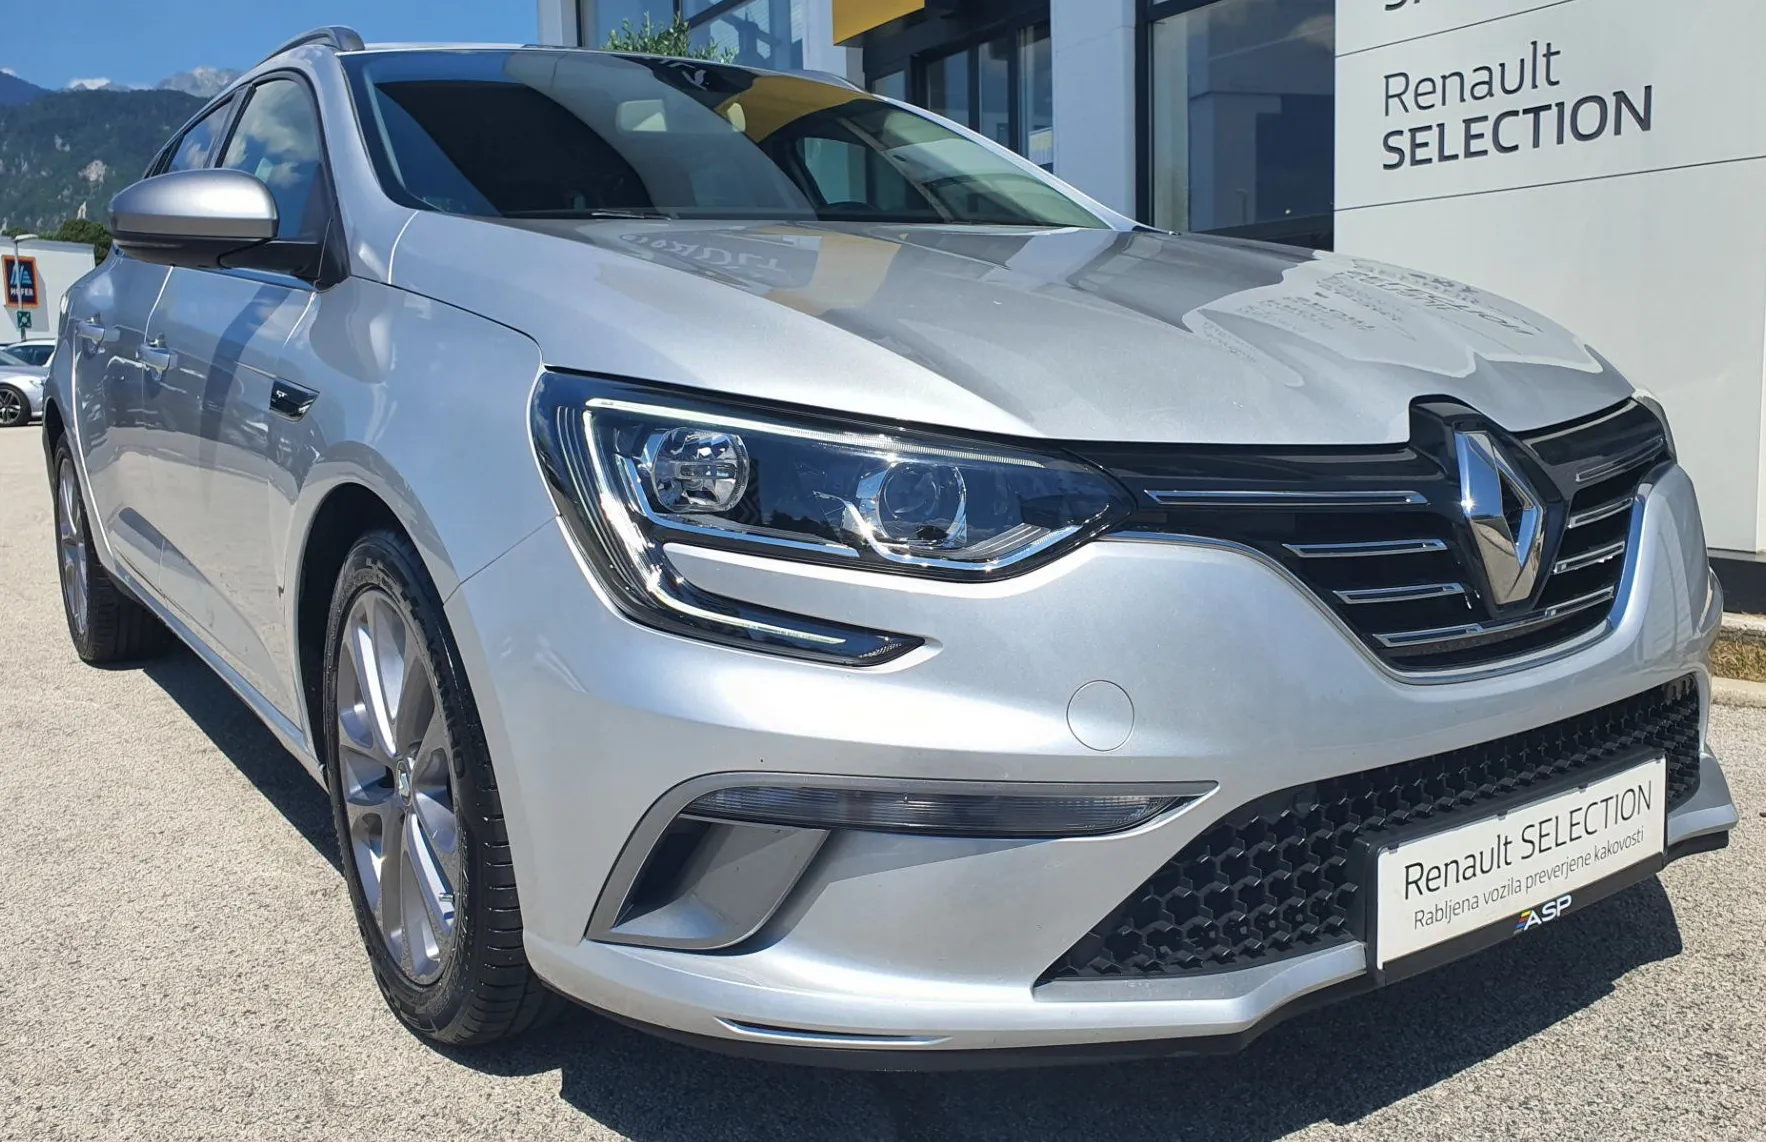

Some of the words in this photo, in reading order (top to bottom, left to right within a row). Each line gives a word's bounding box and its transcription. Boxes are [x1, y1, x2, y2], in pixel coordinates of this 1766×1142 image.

[1384, 41, 1561, 117] Renault
[1383, 85, 1653, 171] SELECTION
[1405, 834, 1513, 900] Renault
[1521, 780, 1652, 860] SELECTION
[1414, 895, 1479, 930] Rabljena
[1483, 877, 1522, 905] vozila
[1525, 851, 1591, 894] preverjene
[1594, 826, 1644, 862] kakovosti
[1523, 894, 1572, 931] ASP
